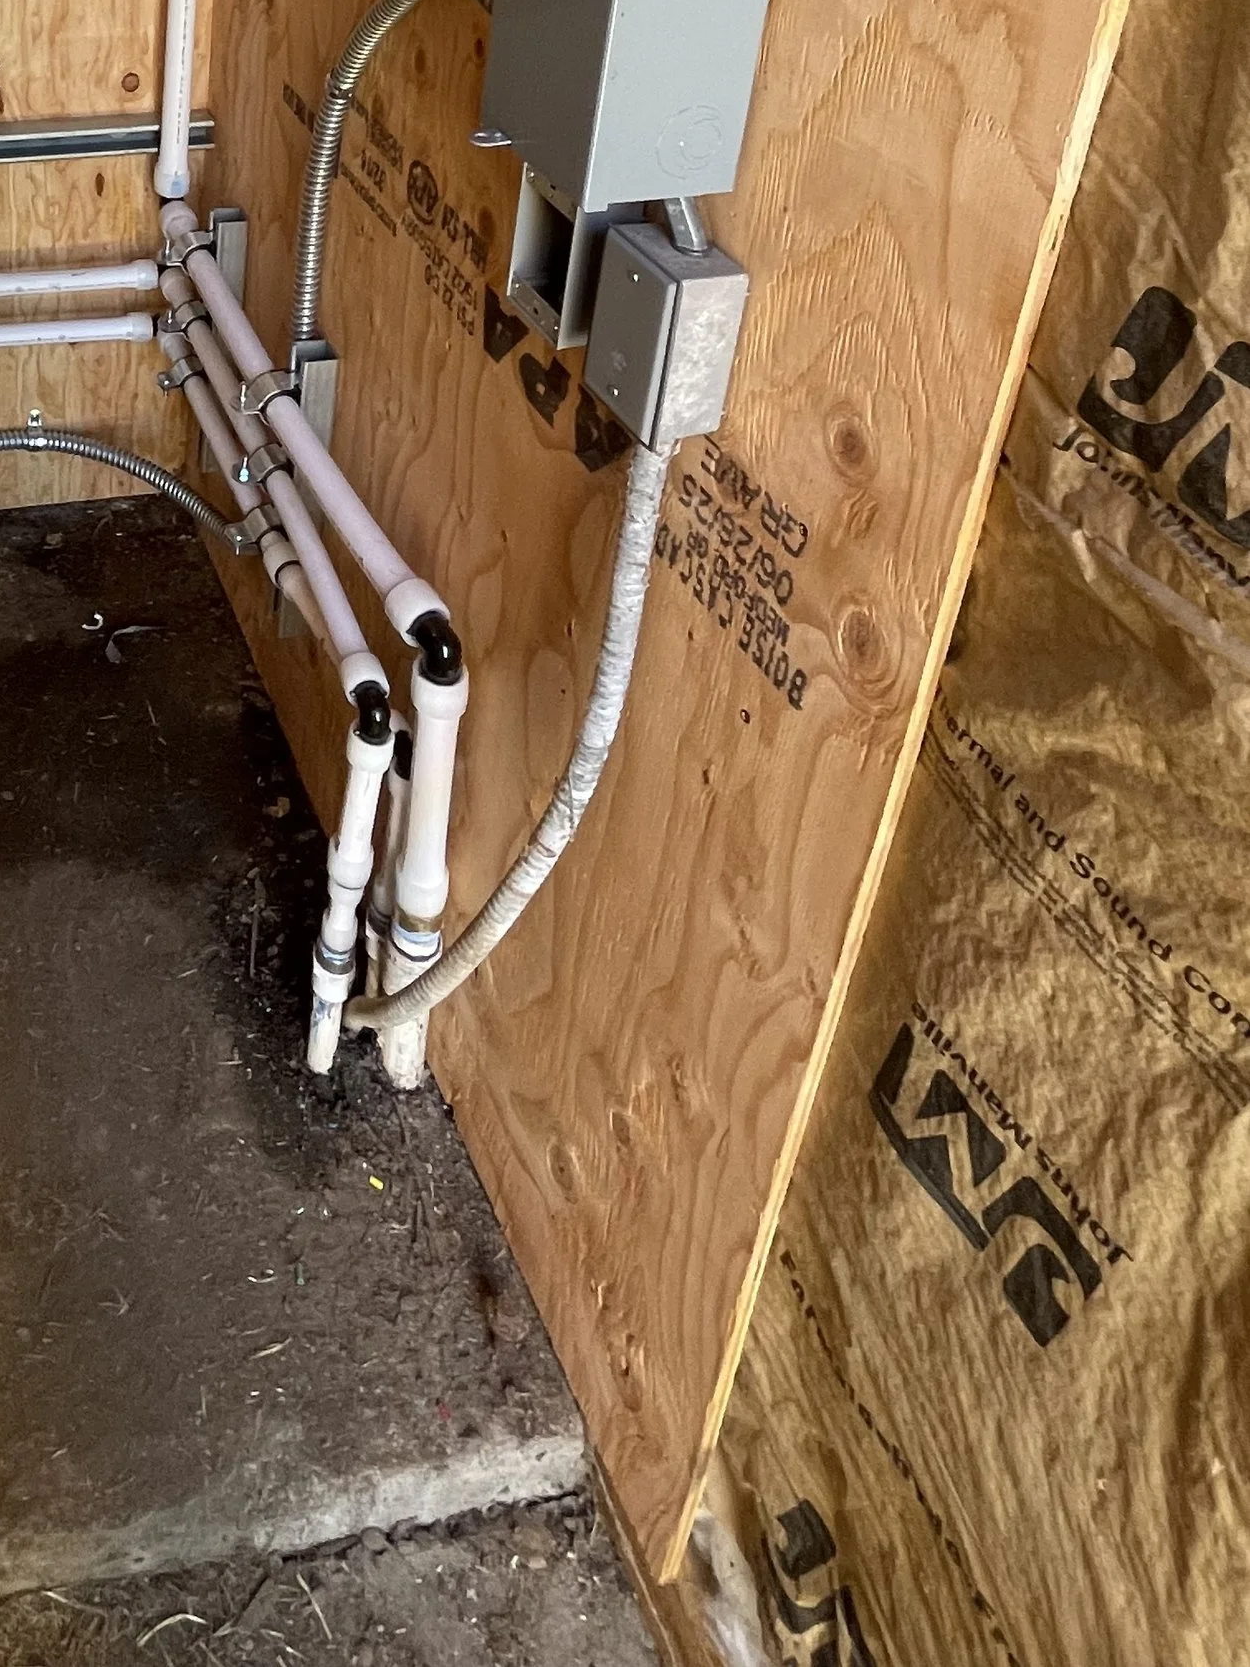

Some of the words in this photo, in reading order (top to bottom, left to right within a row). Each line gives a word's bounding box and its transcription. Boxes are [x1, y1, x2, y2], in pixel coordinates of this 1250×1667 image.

[483, 283, 633, 473] APA
[701, 434, 808, 558] GRAVE
[655, 523, 734, 630] CASCAD
[738, 613, 807, 711] BOISE
[1014, 792, 1067, 853] and
[1069, 851, 1173, 963] Sound
[911, 1000, 1034, 1151] Manville
[868, 1022, 1102, 1348] JM
[1035, 1146, 1134, 1266] Johns
